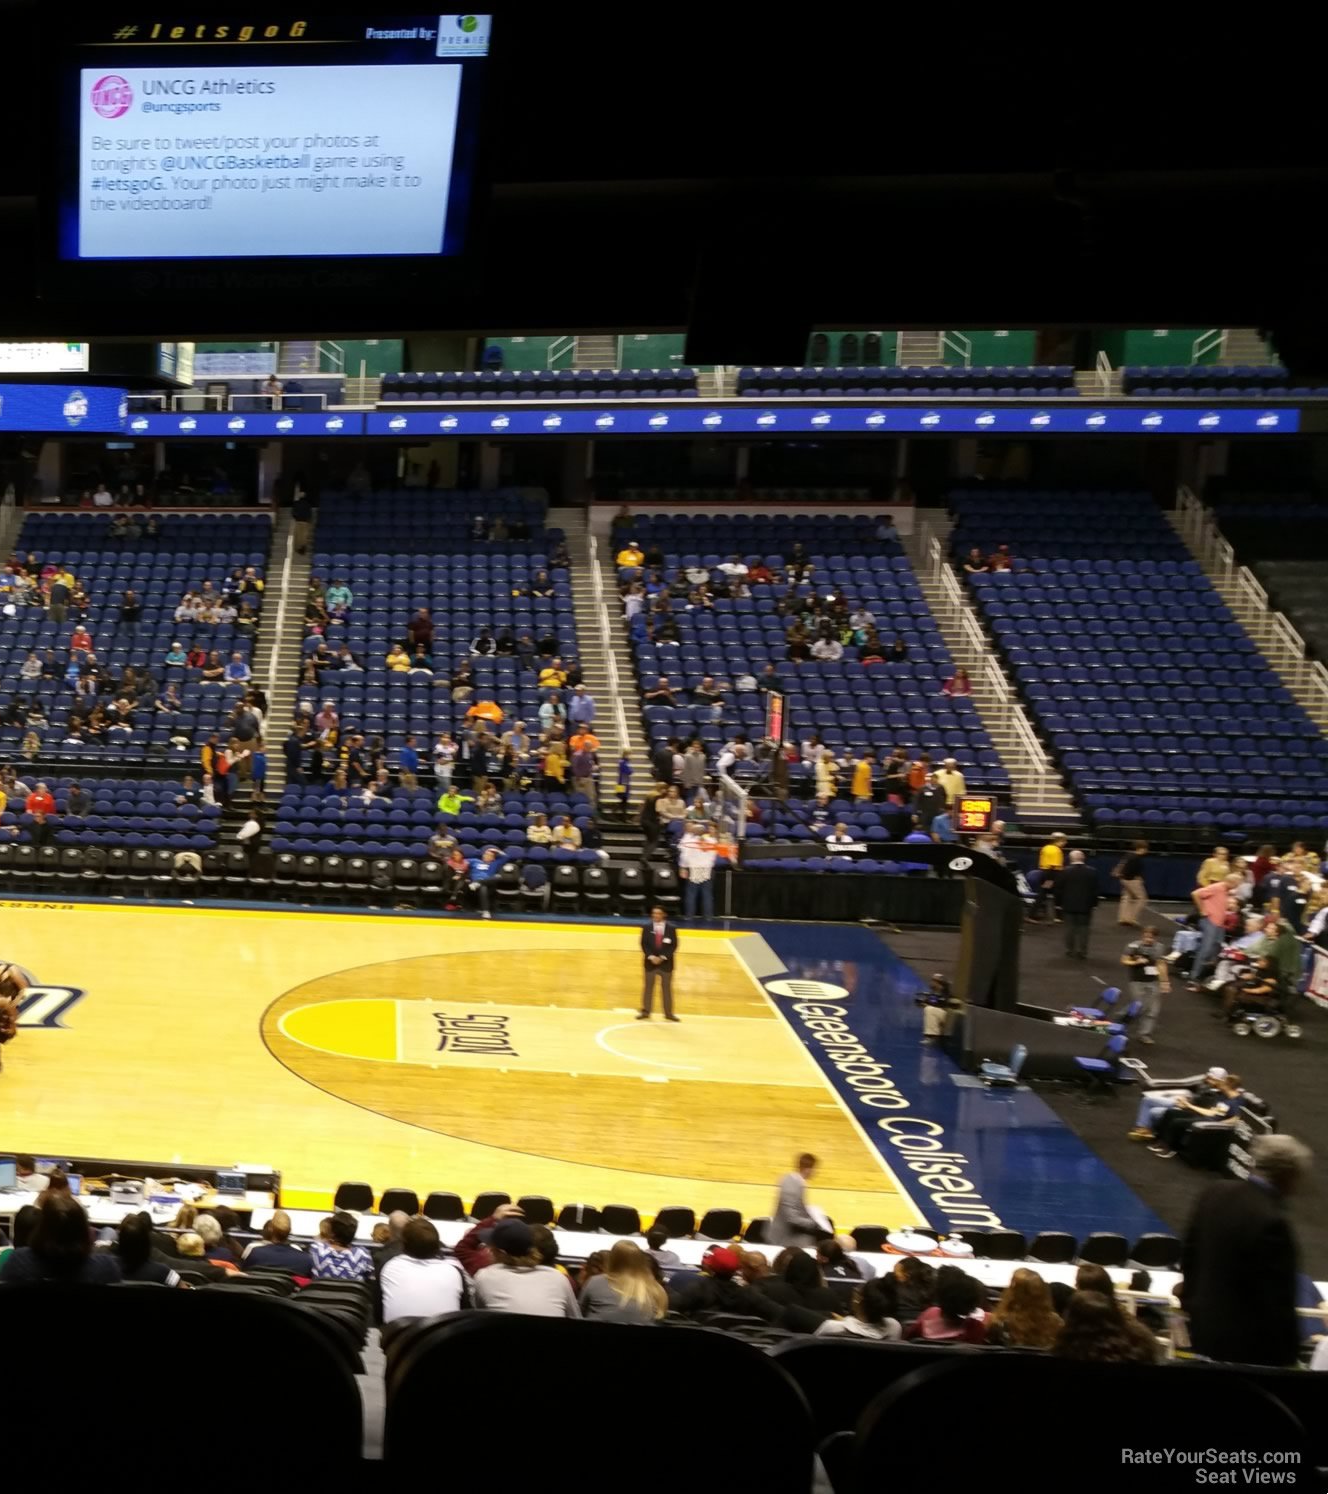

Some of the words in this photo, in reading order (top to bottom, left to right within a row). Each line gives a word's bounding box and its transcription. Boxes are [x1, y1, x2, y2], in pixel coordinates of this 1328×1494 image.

[366, 27, 418, 39] Presented
[142, 80, 196, 95] UNCG
[199, 78, 276, 95] Athletics
[141, 102, 221, 114] @uncgsports
[91, 136, 113, 150] Be
[116, 138, 151, 150] sure
[154, 137, 171, 150] to
[175, 136, 259, 152] tweet/post
[263, 137, 299, 152] your
[303, 133, 360, 151] photos
[363, 135, 380, 148] at
[91, 155, 157, 174] tonight's
[161, 154, 310, 171] @UNCGBasketball
[313, 156, 358, 172] game
[362, 154, 405, 171] using
[91, 176, 168, 194] #letsgoG.
[171, 176, 208, 190] Your
[211, 175, 258, 193] photo
[261, 175, 291, 193] just
[295, 174, 340, 192] might
[343, 173, 387, 188] make
[390, 174, 401, 187] it
[404, 175, 421, 188] to
[90, 197, 116, 211] the
[121, 195, 212, 211] videoboard!
[791, 1003, 911, 1109] Greensboro
